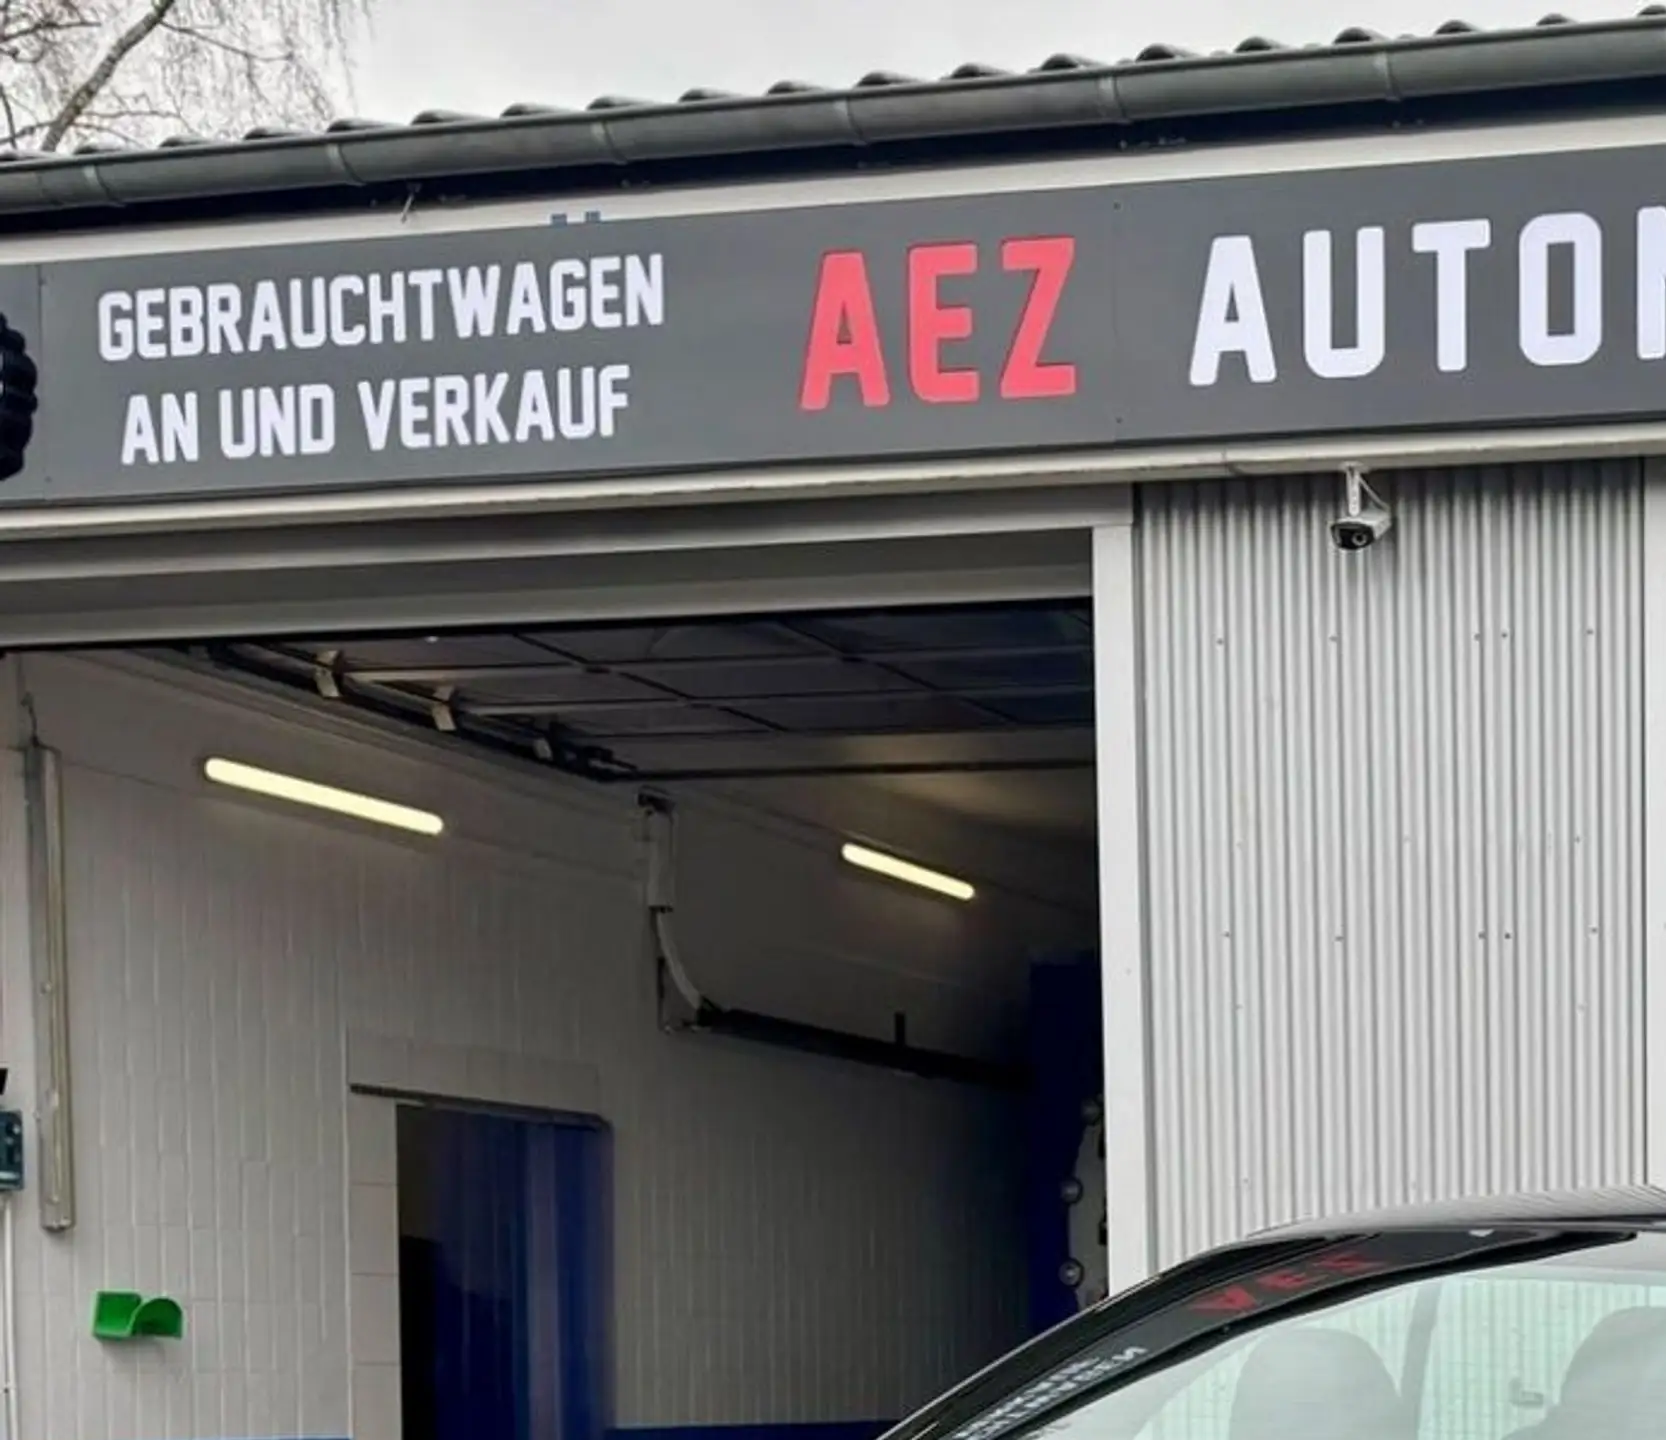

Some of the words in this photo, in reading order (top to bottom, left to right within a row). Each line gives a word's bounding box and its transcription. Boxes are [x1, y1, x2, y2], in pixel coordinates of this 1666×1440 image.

[98, 253, 665, 362] GEBRAUCHTWAGEN
[799, 236, 1078, 411] AEZ
[122, 392, 198, 465] AN
[219, 384, 334, 459] UND
[359, 364, 630, 451] VERKAUF
